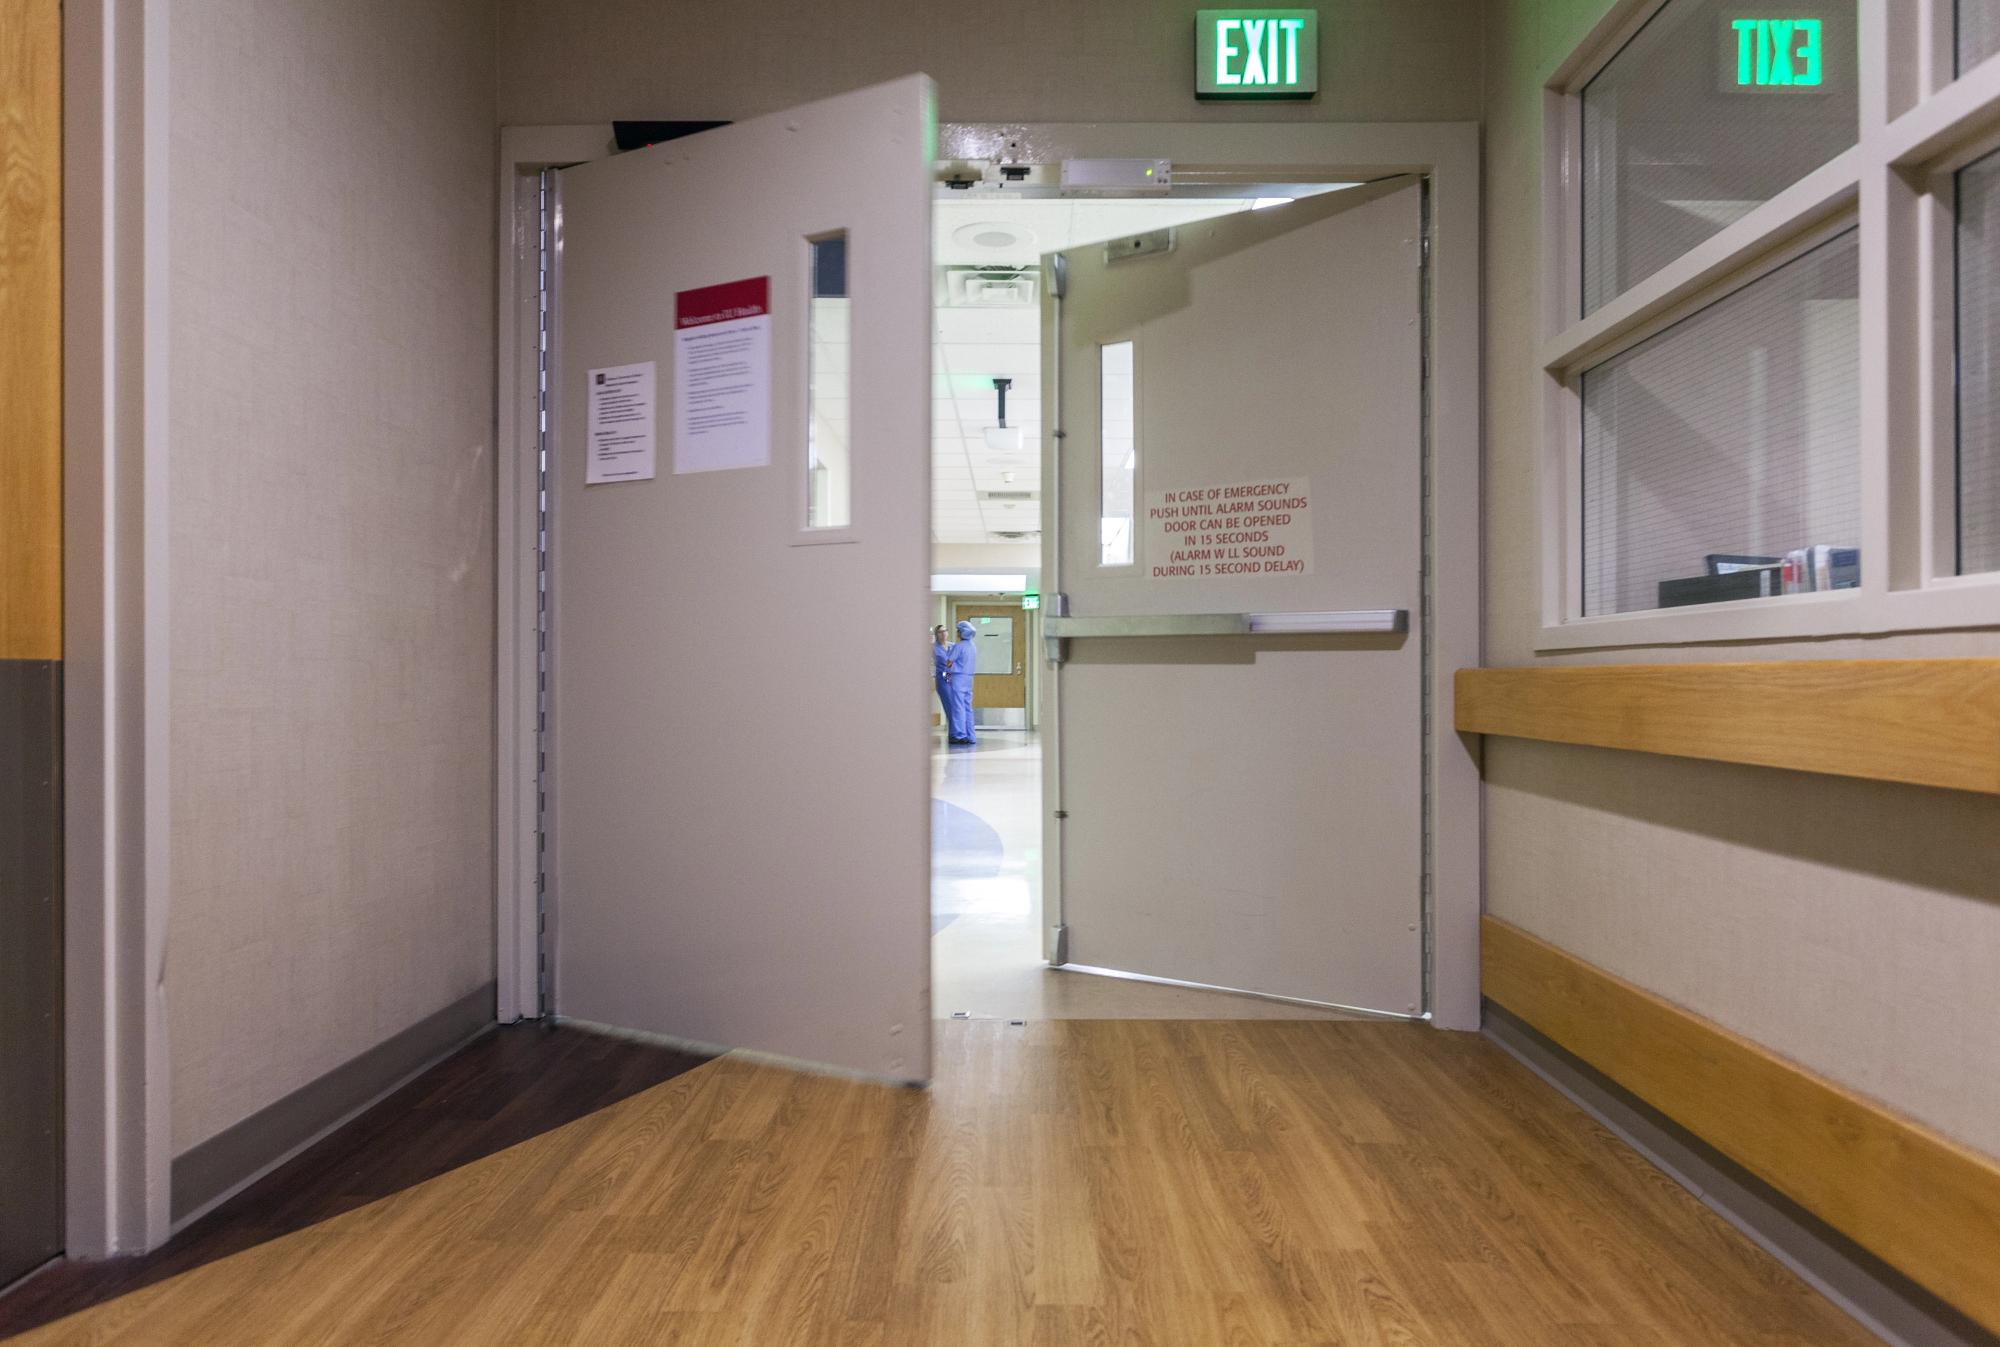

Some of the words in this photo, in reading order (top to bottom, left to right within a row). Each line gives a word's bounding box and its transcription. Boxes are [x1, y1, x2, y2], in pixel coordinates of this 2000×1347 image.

[1216, 18, 1304, 85] EXIT
[1165, 493, 1175, 503] IN
[1179, 490, 1204, 502] CASE
[1207, 488, 1221, 500] OF
[1224, 483, 1290, 499] EMERGENCY
[1150, 507, 1179, 519] PUSH
[1182, 504, 1213, 517] UNTIL
[1216, 501, 1254, 514] ALARM
[1258, 497, 1307, 511] SOUNDS
[1165, 521, 1196, 532] DOOR
[1200, 519, 1222, 530] CAN
[1226, 517, 1240, 528] BE
[1244, 514, 1291, 527] OPENED
[1184, 535, 1196, 546] IN
[1201, 535, 1212, 545] 15
[1216, 531, 1268, 544] SECONDS
[1170, 549, 1211, 563] (ALARM
[1214, 548, 1240, 559] WLL
[1243, 545, 1284, 557] SOUND
[1153, 565, 1195, 577] DURING
[1200, 564, 1211, 575] 15
[1214, 562, 1261, 574] SECOND
[1264, 559, 1304, 574] DELAY)
